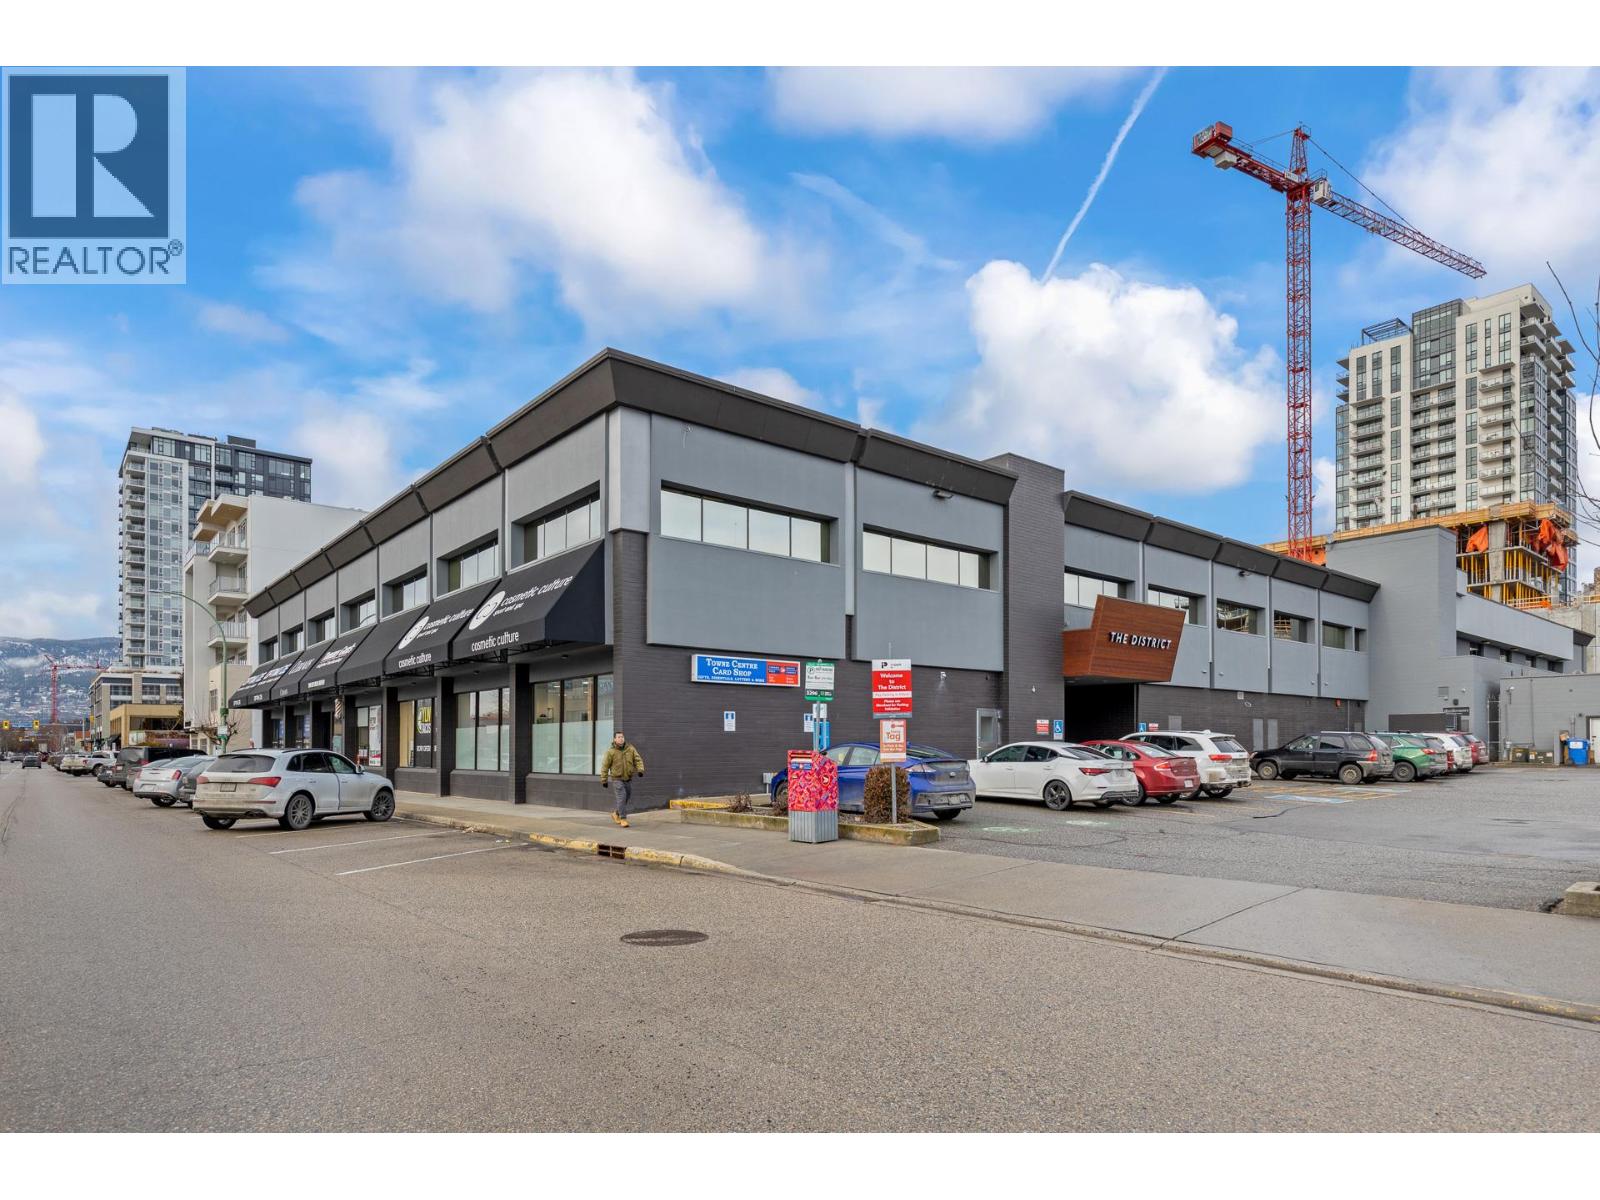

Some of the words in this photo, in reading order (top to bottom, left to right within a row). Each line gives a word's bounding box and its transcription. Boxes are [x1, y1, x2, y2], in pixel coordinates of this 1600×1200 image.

[500, 586, 540, 607] cosmetic
[537, 575, 574, 595] culture
[448, 608, 475, 623] culture
[471, 635, 497, 652] cosmetic
[496, 631, 520, 646] culture
[1109, 631, 1129, 644] THE
[1130, 634, 1172, 650] DISTRICT
[398, 654, 417, 669] cosmetic
[416, 652, 432, 664] culture
[886, 731, 901, 742] Tag
